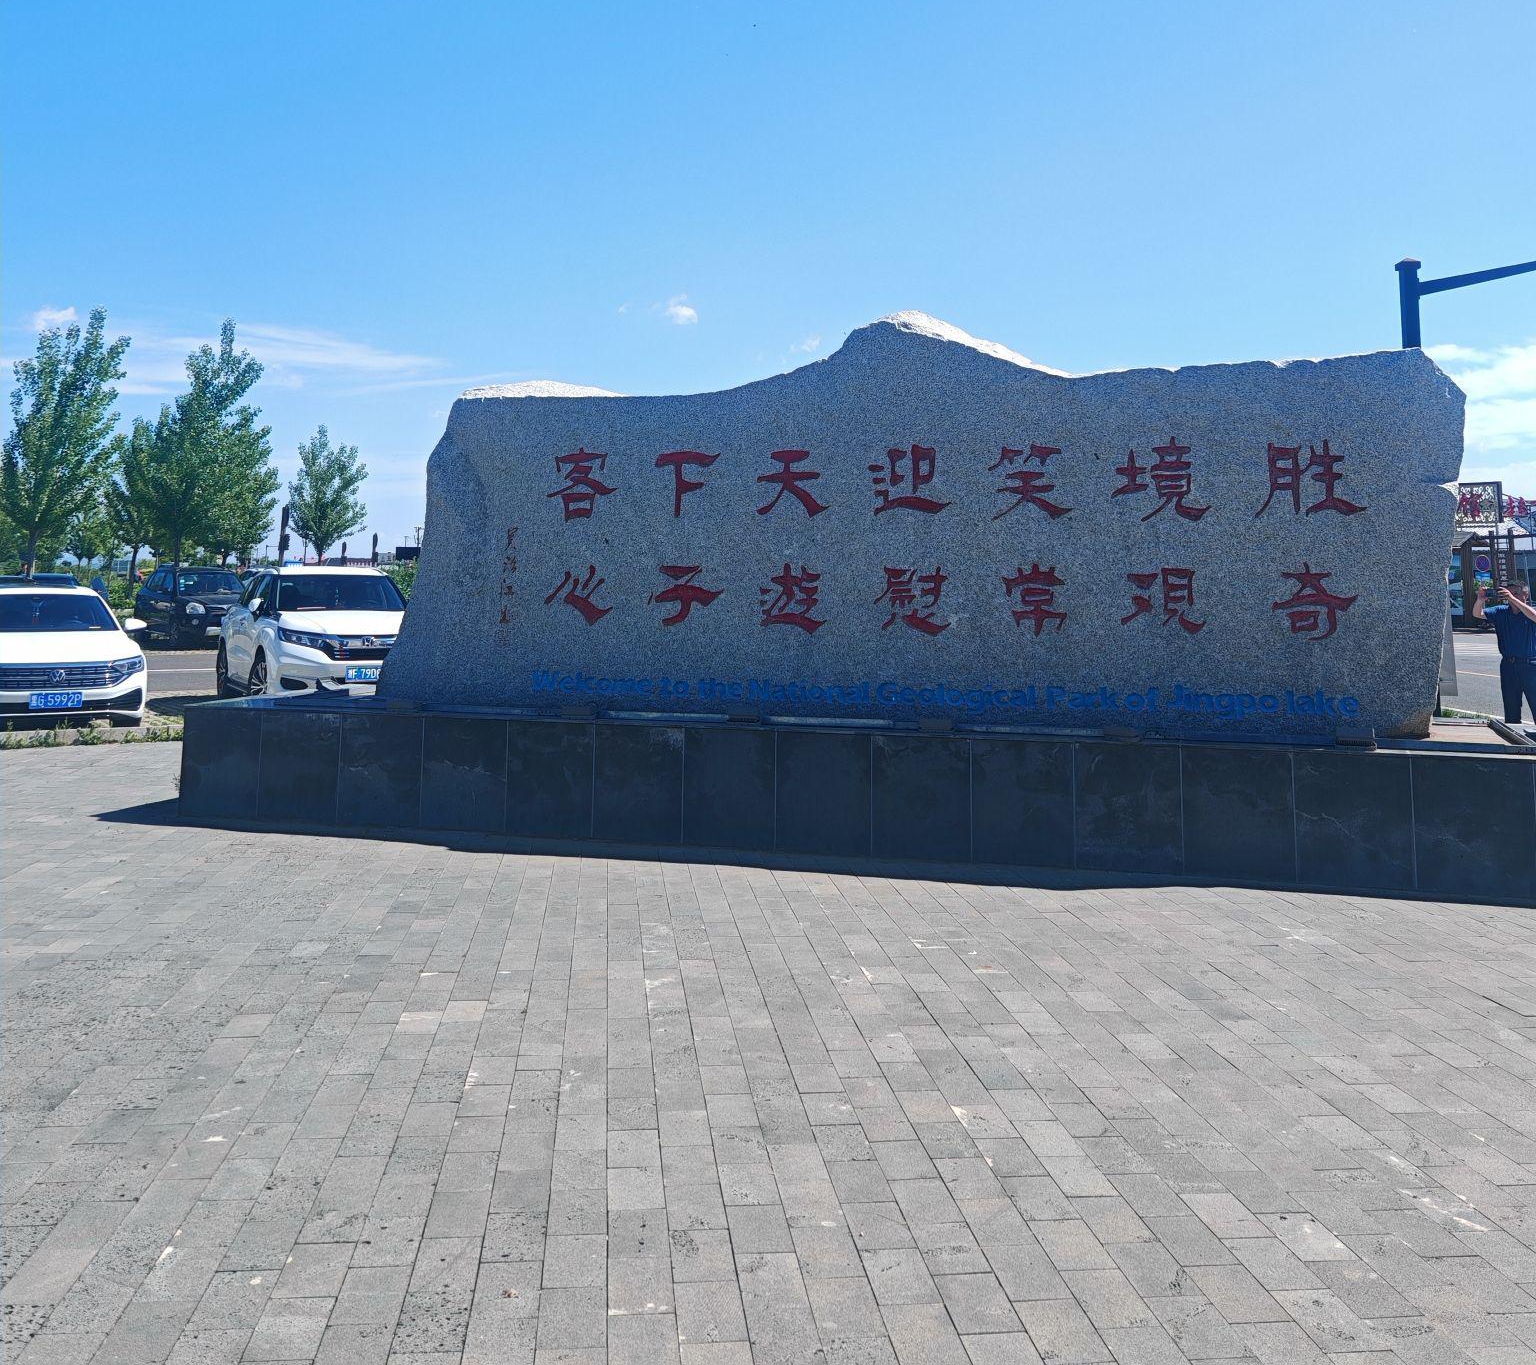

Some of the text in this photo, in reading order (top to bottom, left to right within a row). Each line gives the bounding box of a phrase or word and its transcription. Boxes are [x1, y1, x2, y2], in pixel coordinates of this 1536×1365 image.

[532, 671, 1359, 719] Welcome to the National Geological Park of Jingpo lake
